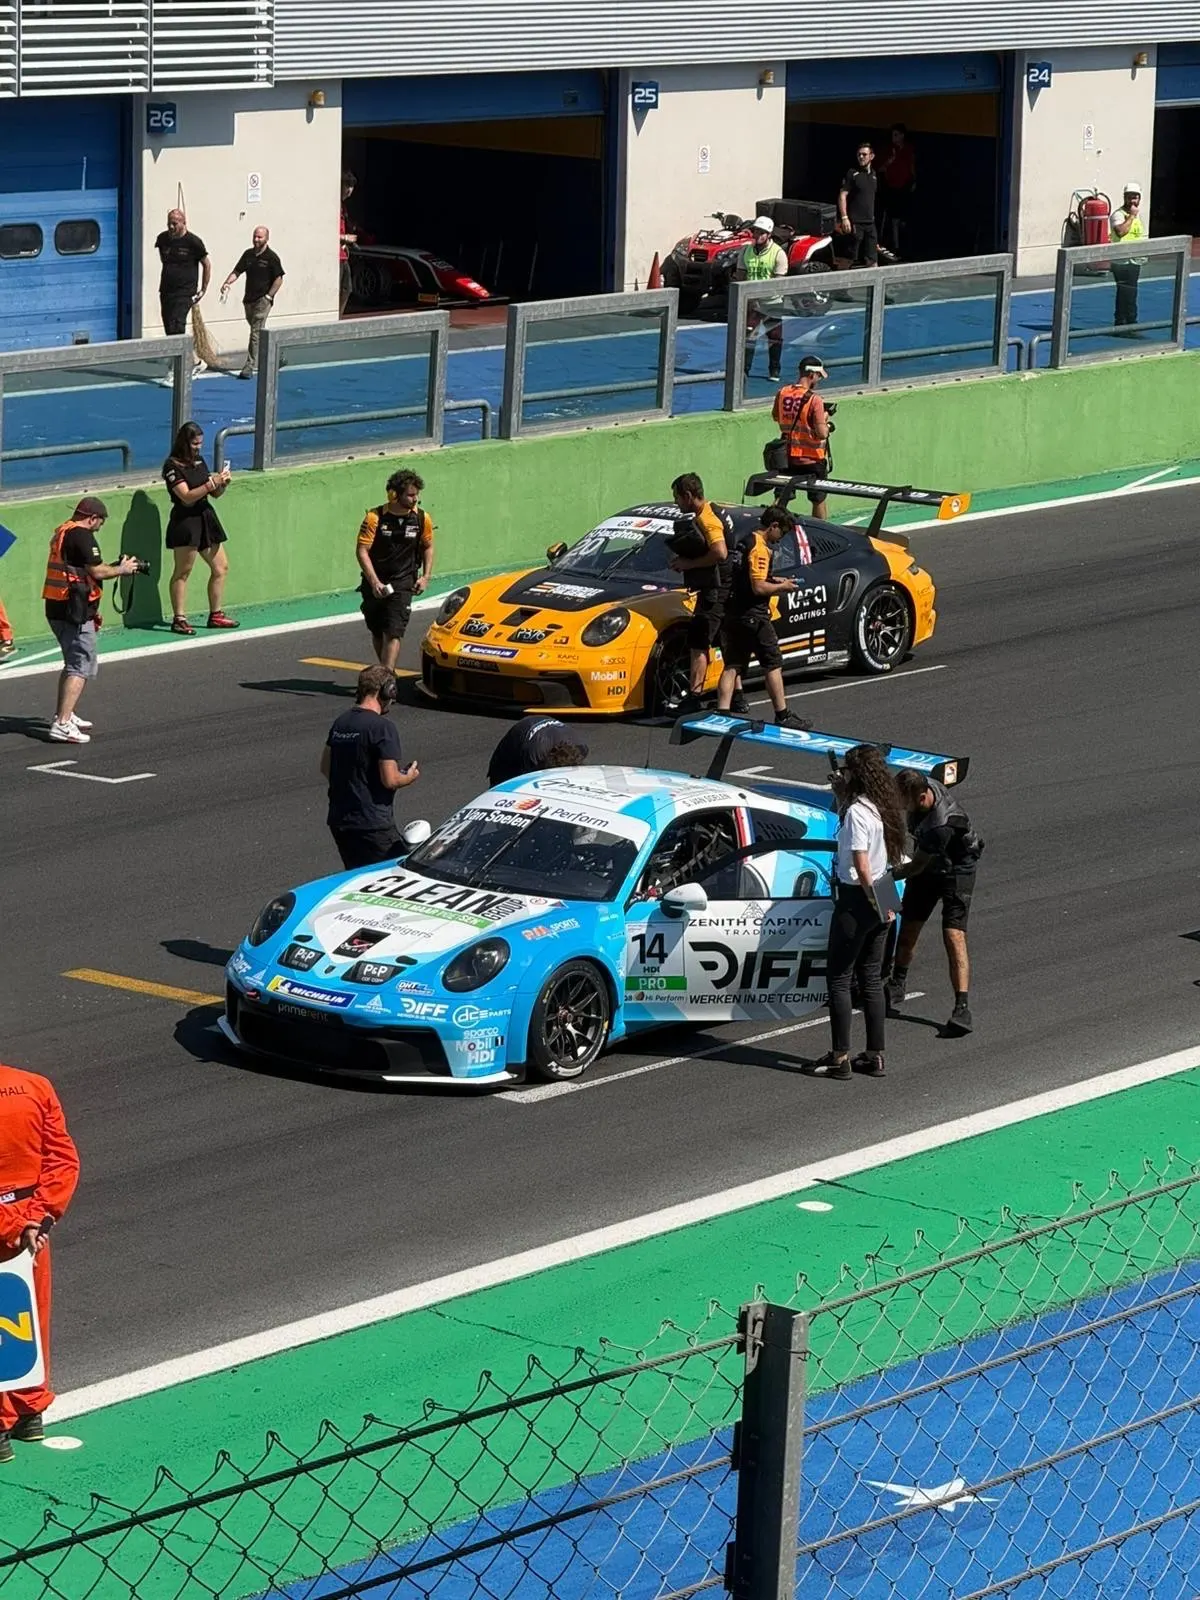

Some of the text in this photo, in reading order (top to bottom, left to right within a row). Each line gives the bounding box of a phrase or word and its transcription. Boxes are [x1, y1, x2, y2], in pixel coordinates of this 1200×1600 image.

[1029, 69, 1049, 82] 24
[635, 88, 656, 103] 25
[150, 111, 174, 127] 26
[787, 585, 827, 610] KAPCI
[789, 608, 827, 623] COATINGS
[471, 647, 513, 657] MICHELIN
[591, 671, 618, 681] Mobil
[607, 686, 627, 696] HDI
[463, 809, 488, 821] Van
[485, 810, 532, 828] Soelen
[494, 799, 516, 808] Q8
[553, 807, 610, 828] Perform
[359, 875, 511, 916] CLEAN
[481, 899, 527, 920] GROUP
[689, 918, 823, 927] ZENITH CAPITAL
[725, 928, 786, 936] TRADING
[295, 949, 315, 961] P&P
[632, 933, 668, 964] 14
[363, 964, 389, 977] P&P
[639, 977, 667, 989] PRO
[290, 987, 346, 1003] MICHELIN
[655, 994, 685, 1002] Perform
[689, 992, 832, 1004] WERKEN IN DE TECHNIE
[278, 1003, 329, 1022] primerent
[400, 997, 449, 1017] DIFF
[489, 1009, 511, 1017] PARTS
[463, 1027, 499, 1040] sparco
[456, 1037, 492, 1051] Mobil
[467, 1050, 495, 1065] HDI
[0, 1085, 27, 1096] HALL
